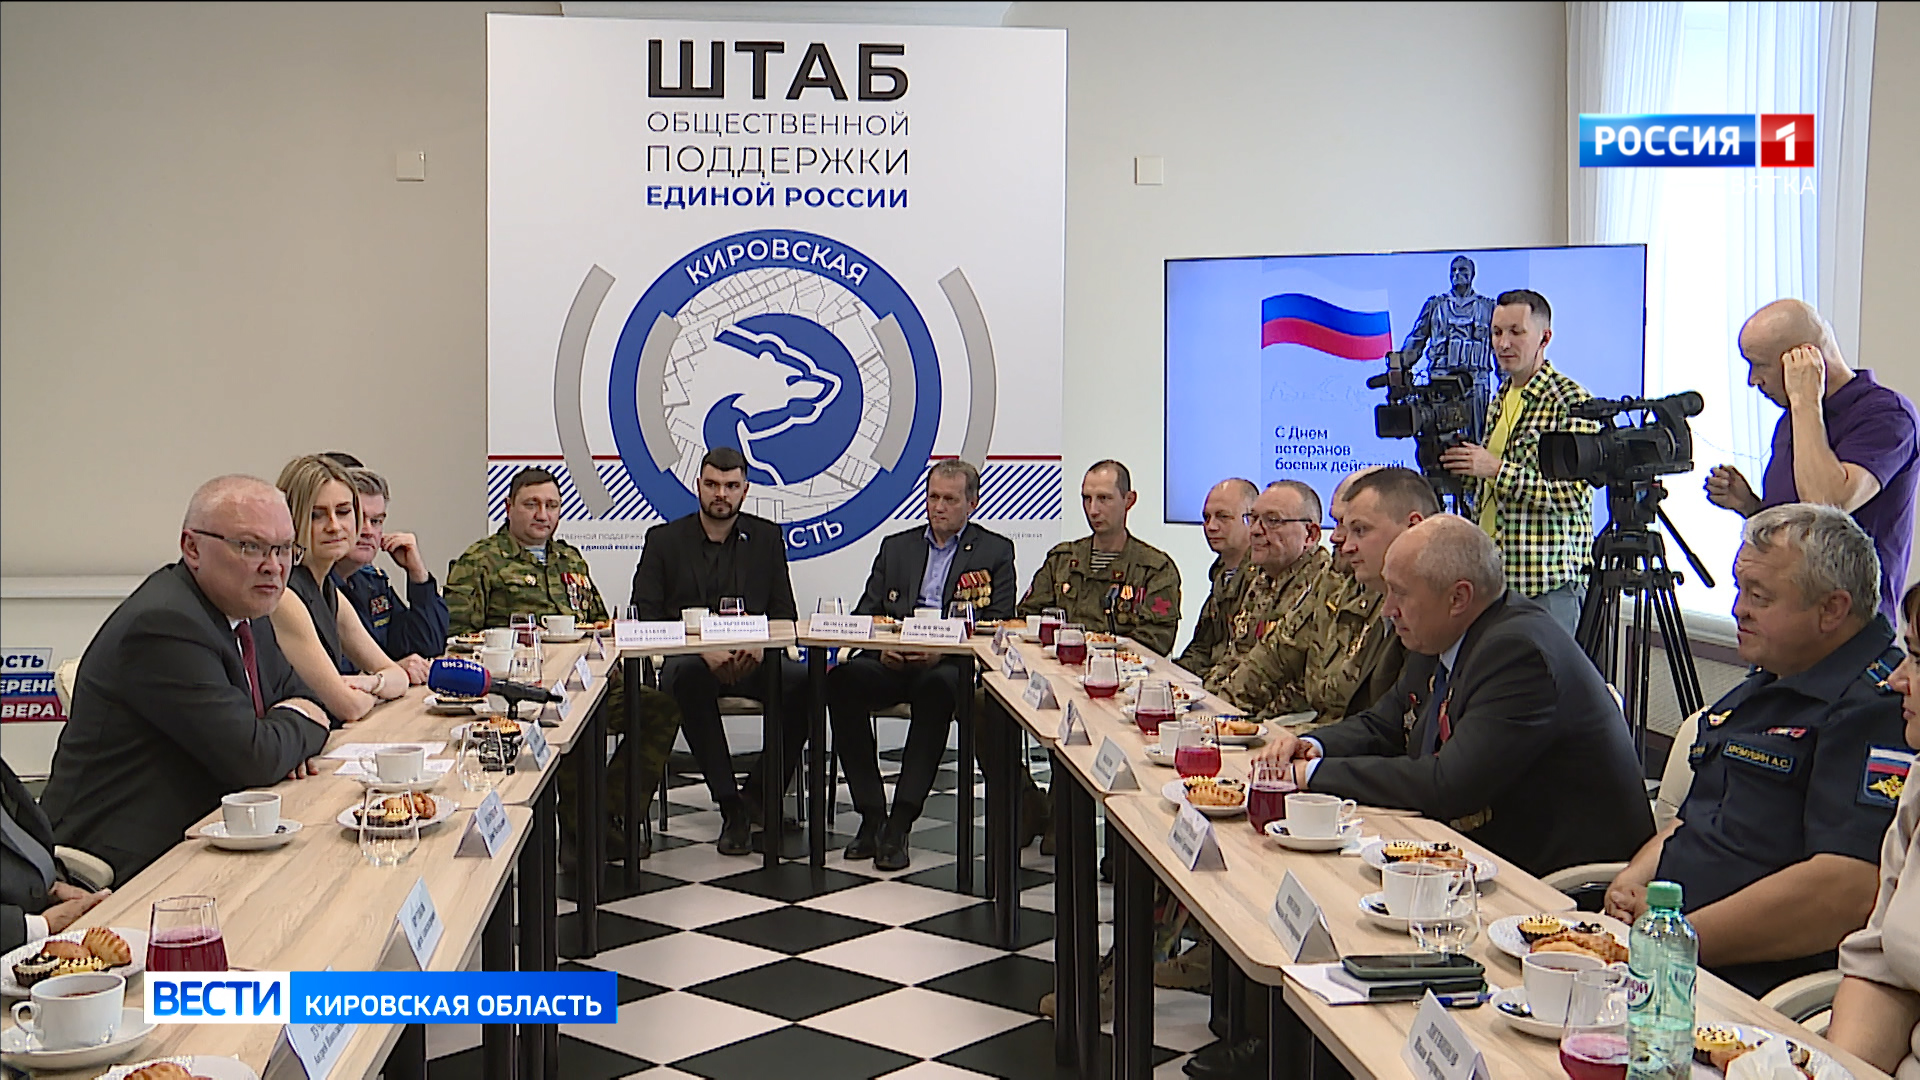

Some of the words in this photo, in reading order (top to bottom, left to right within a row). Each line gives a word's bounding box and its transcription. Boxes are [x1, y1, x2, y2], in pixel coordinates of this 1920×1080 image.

[648, 39, 908, 101] ШТАБ
[647, 110, 909, 137] ОБЩЕСТВЕННОЙ
[647, 145, 908, 178] ПОДДЕРЖКИ
[647, 182, 775, 210] ЕДИНОЙ
[785, 187, 908, 208] РОССИИ
[685, 238, 869, 286] КИРОВСКАЯ
[1288, 425, 1329, 441] Днем
[1274, 444, 1351, 458] ветеранов
[1274, 457, 1328, 471] боевых
[1330, 459, 1405, 474] дейсий!
[783, 520, 844, 550] СТЬ
[1, 703, 56, 718] ВЕРА
